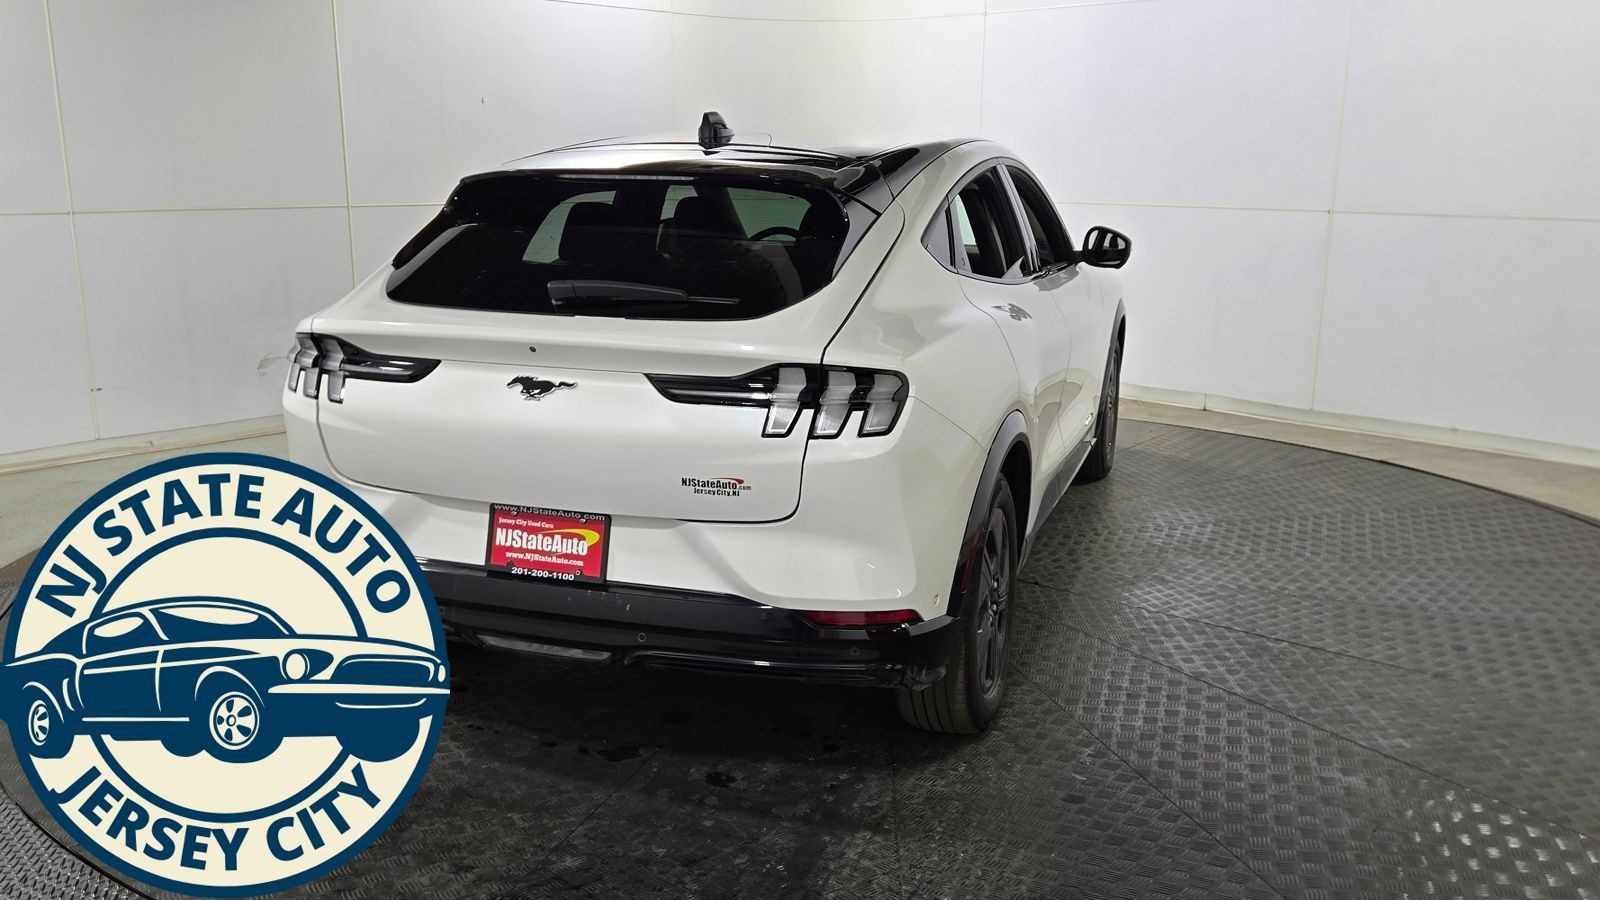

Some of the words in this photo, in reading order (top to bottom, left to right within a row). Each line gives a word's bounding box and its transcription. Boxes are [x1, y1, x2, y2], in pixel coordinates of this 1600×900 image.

[681, 477, 752, 491] NJStateAuto.com
[694, 487, 716, 496] Jersey
[494, 504, 605, 521] www.NJStateAuto.com
[499, 517, 515, 525] Jersey
[516, 519, 527, 527] City
[495, 527, 588, 556] NJStateAuto
[505, 551, 584, 566] www.NJStateAuto.com
[511, 566, 574, 580] 201-200-1100
